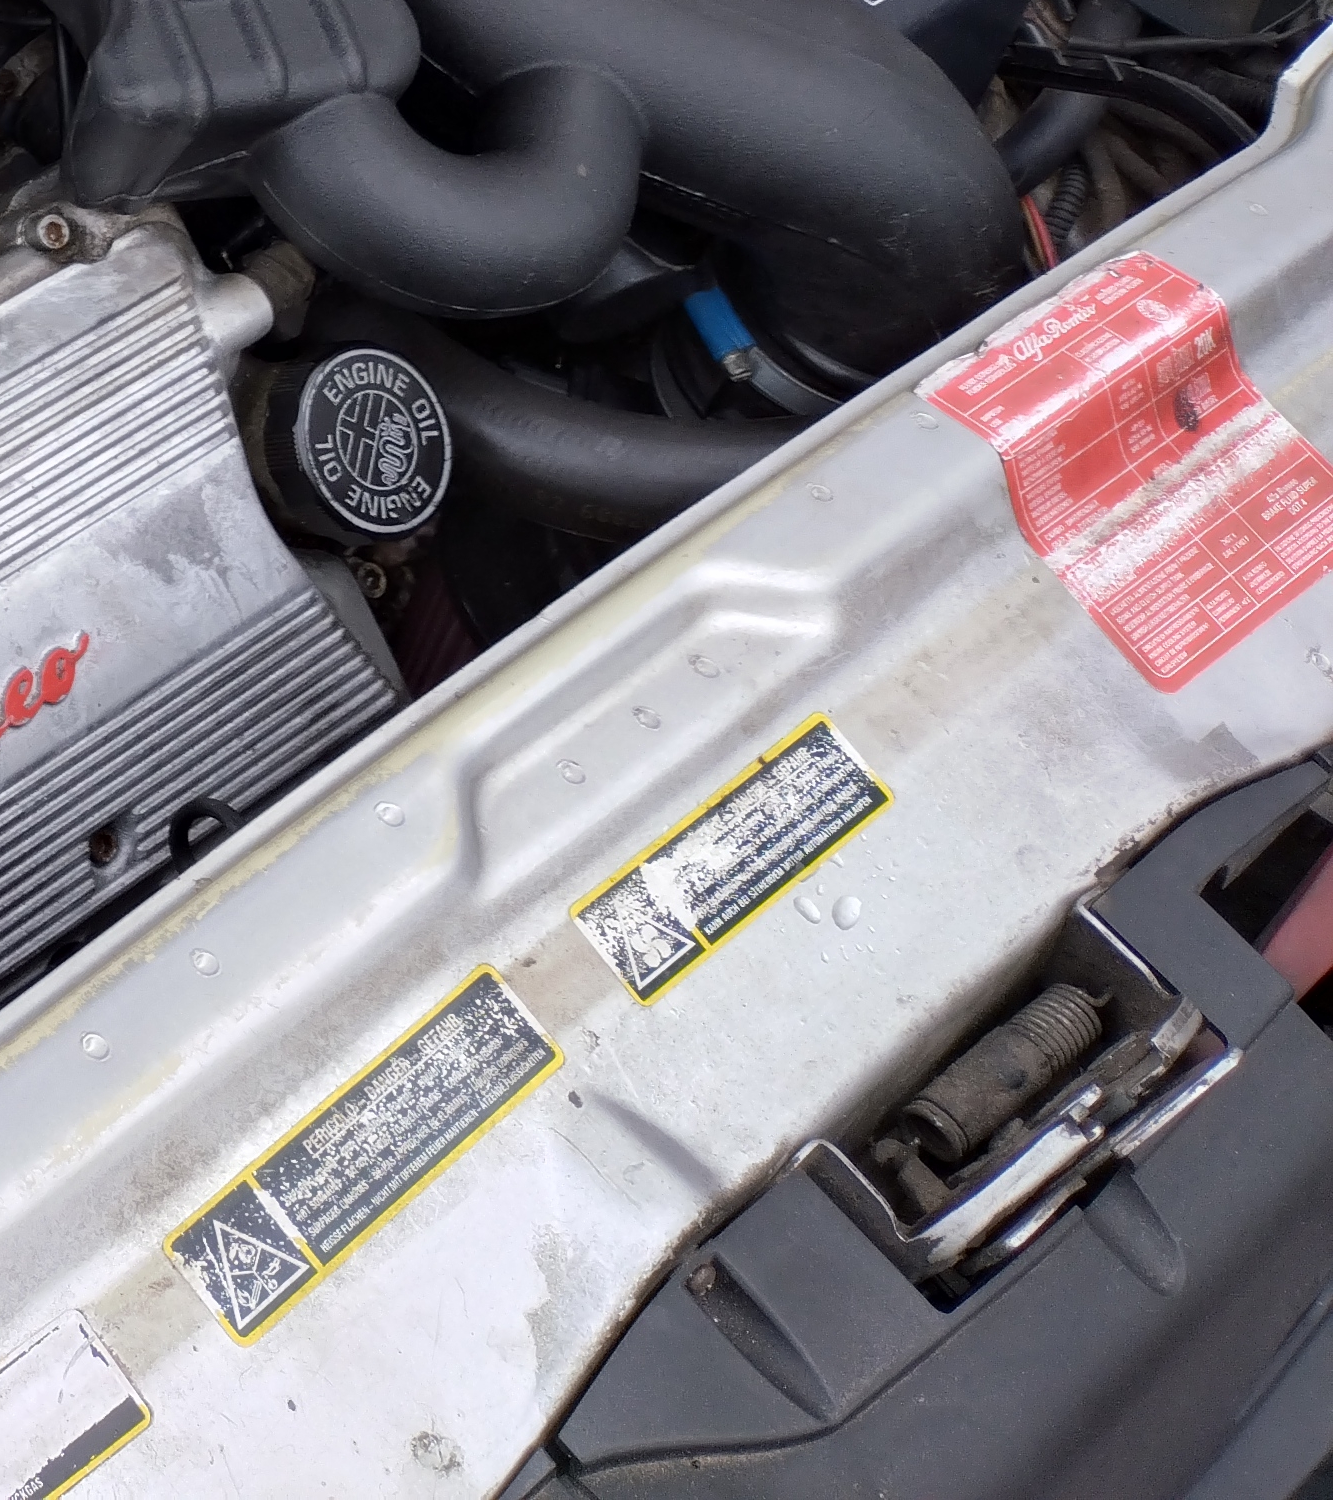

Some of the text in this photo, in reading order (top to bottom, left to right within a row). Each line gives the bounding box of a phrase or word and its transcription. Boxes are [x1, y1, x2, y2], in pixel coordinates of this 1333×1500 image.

[1013, 331, 1048, 362] Alfa
[323, 361, 441, 446] ENGINE OIL
[314, 434, 432, 520] ENGINE OIL
[1260, 475, 1318, 522] BRAKE FLUID SUPER
[1287, 497, 1309, 515] DOT 4
